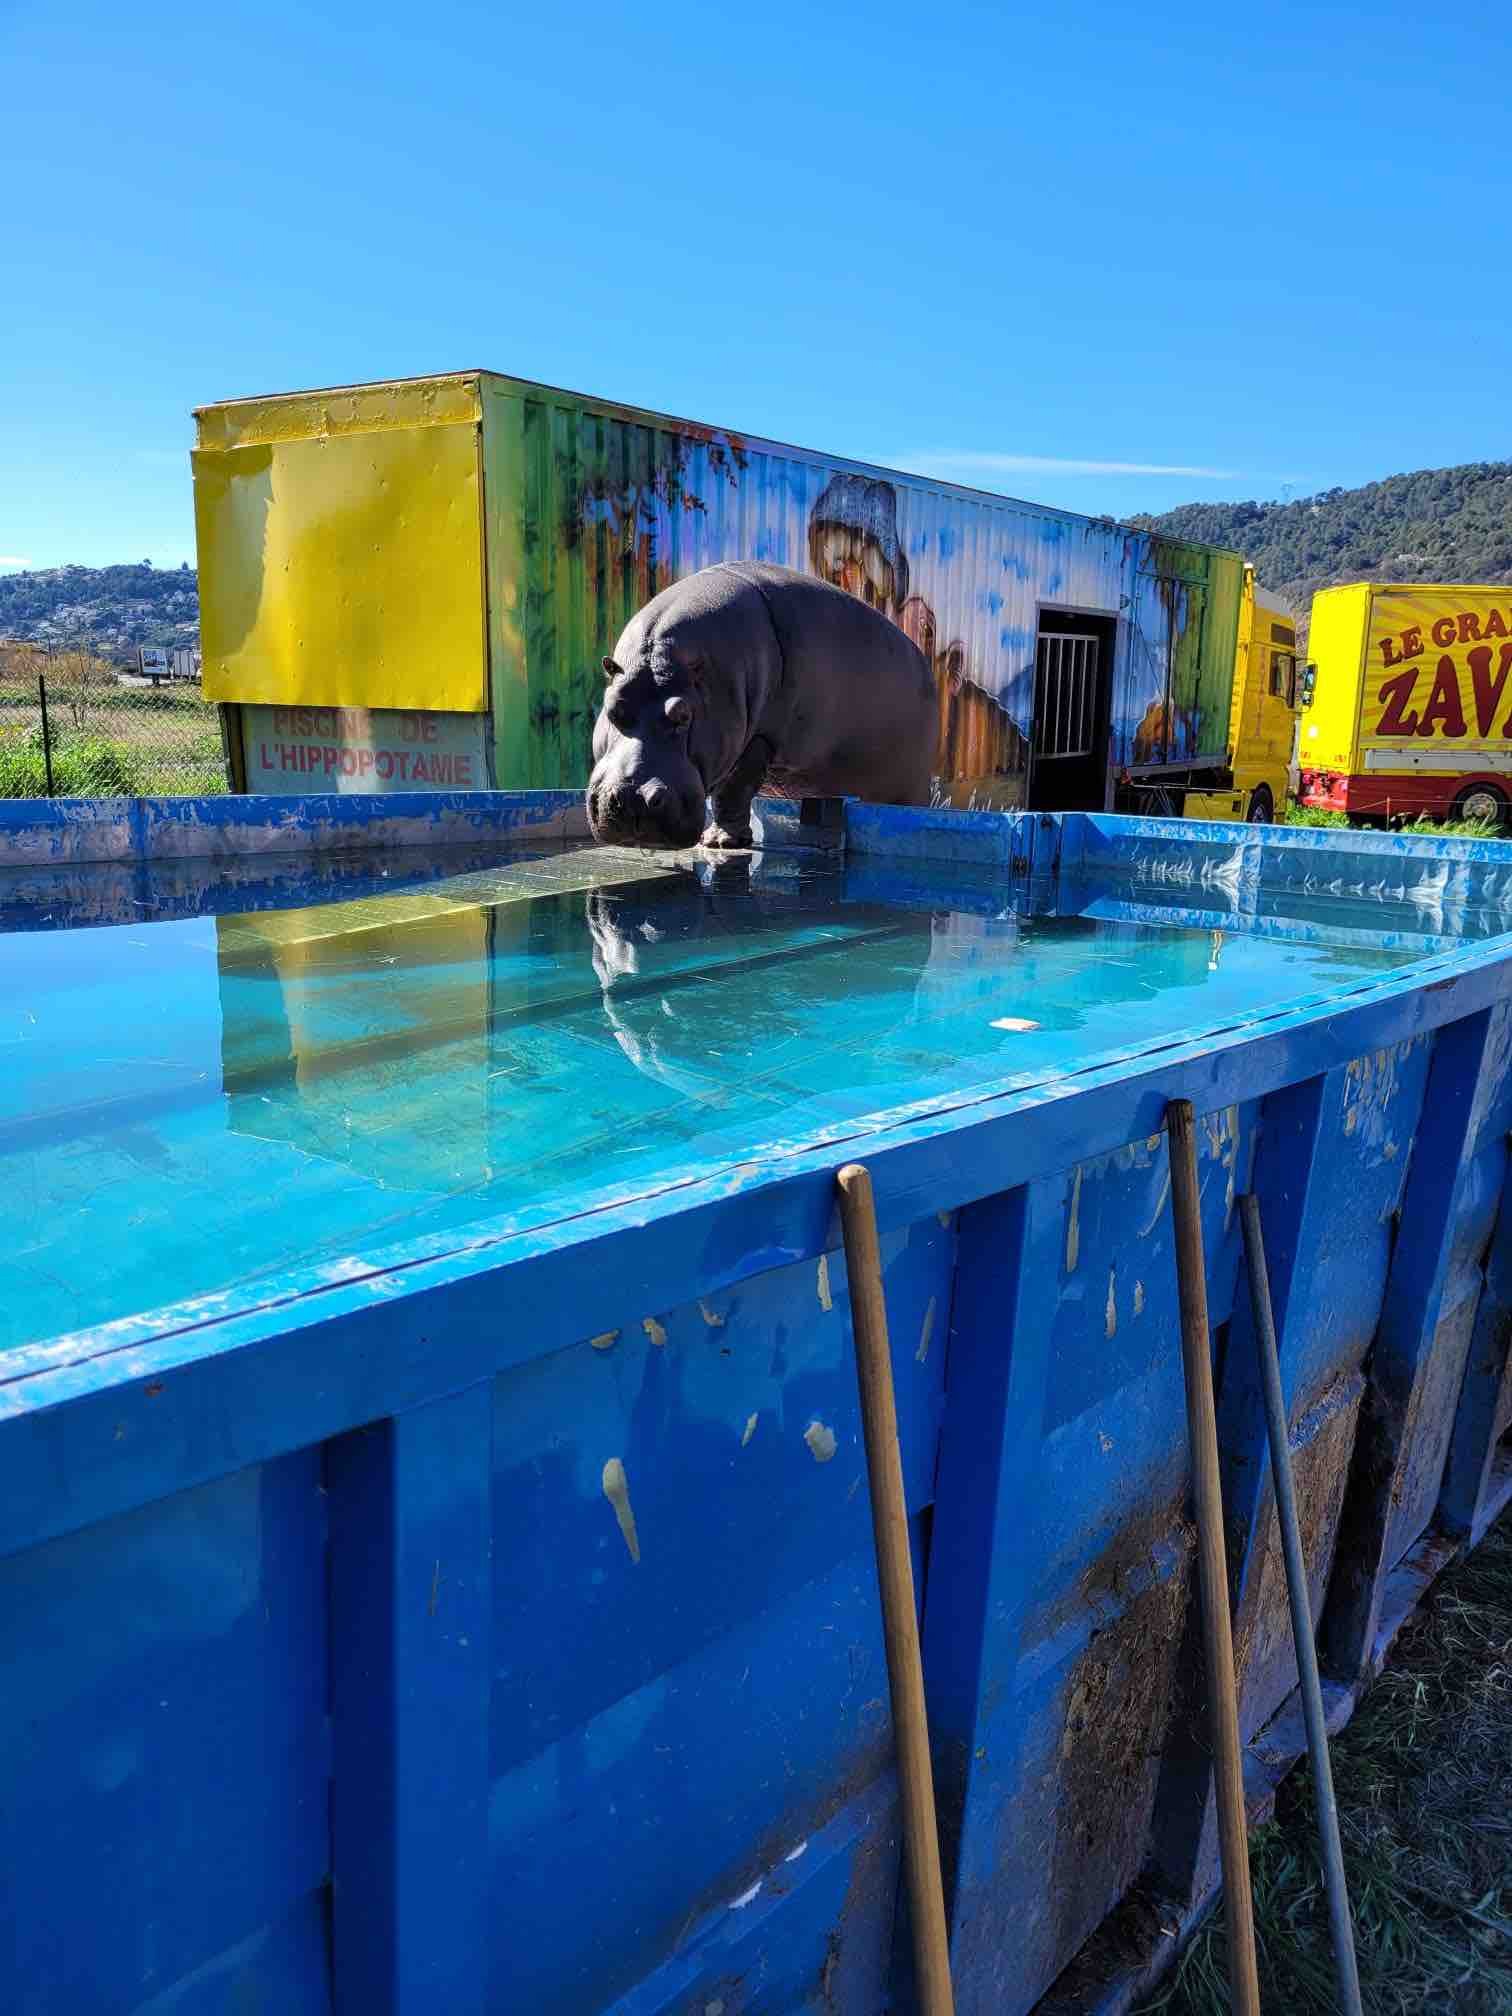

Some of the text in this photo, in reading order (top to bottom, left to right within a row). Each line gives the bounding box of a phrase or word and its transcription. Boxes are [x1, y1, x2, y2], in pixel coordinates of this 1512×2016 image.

[1378, 608, 1512, 668] LE GRA
[1375, 642, 1512, 738] ZAV
[401, 714, 438, 743] DE
[261, 744, 472, 785] L'HIPPOPOTAME
